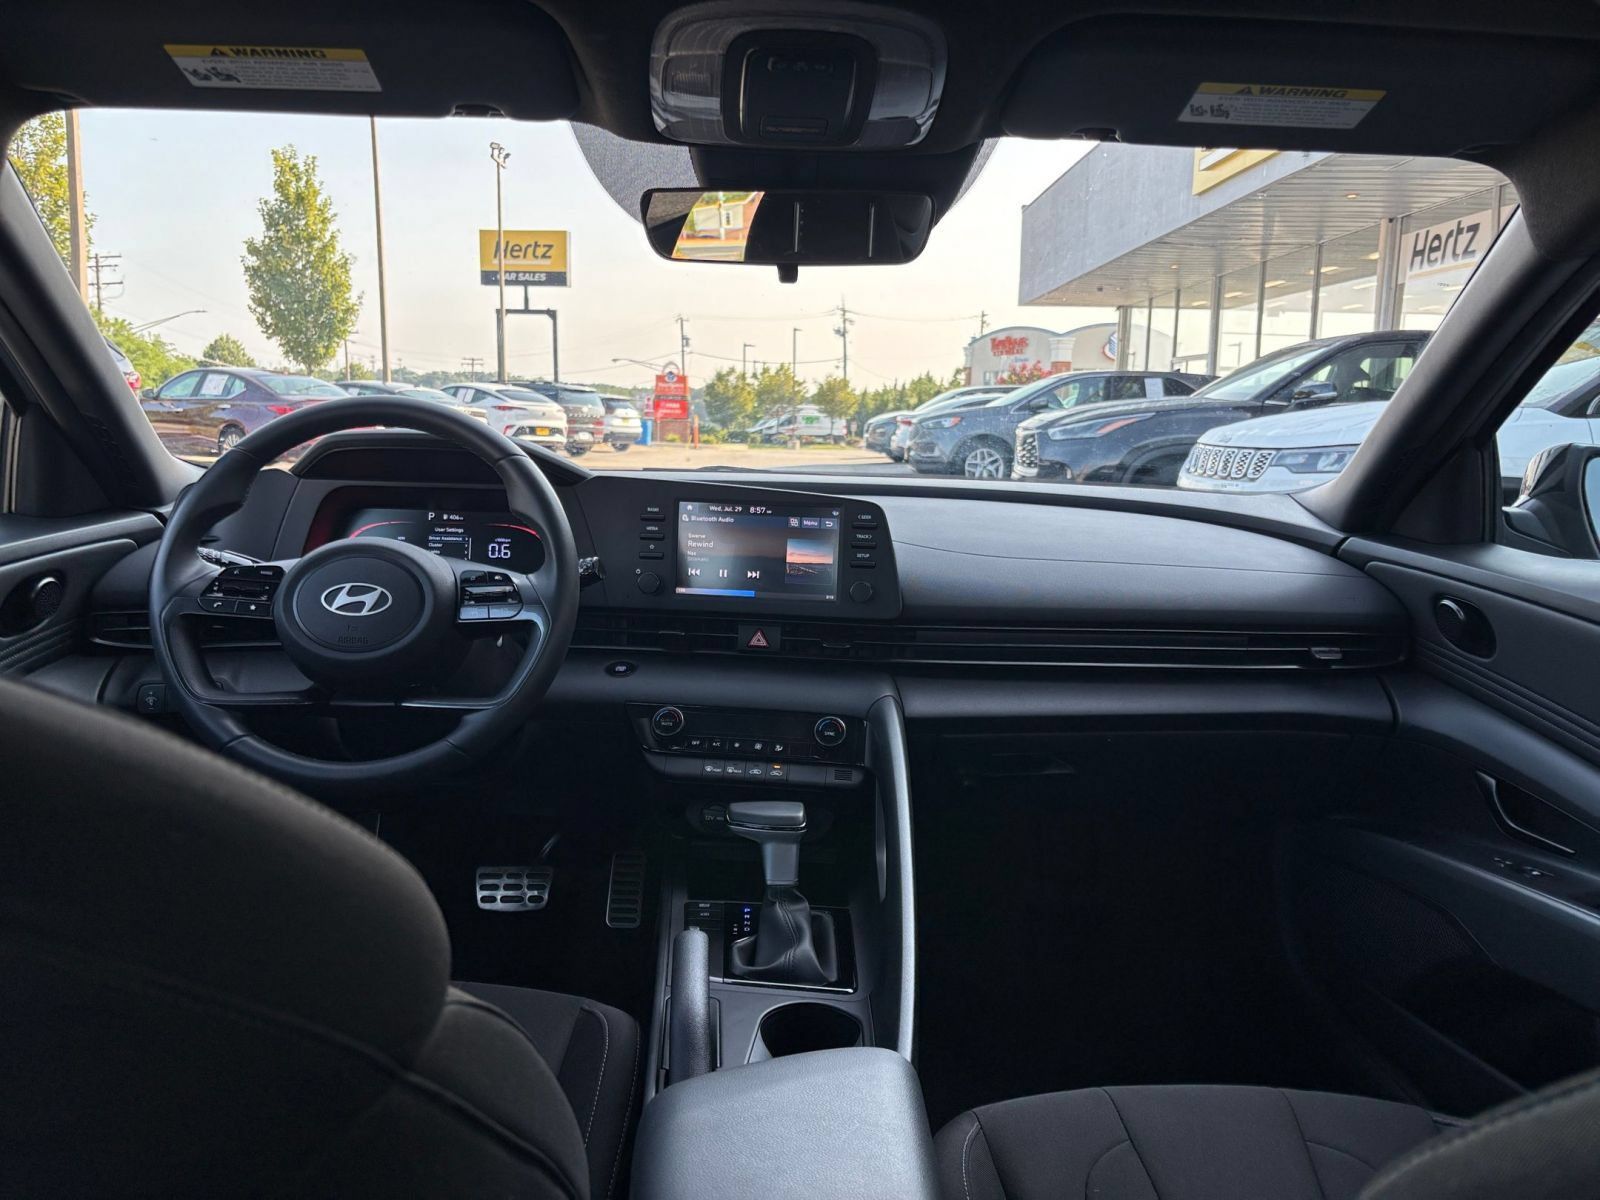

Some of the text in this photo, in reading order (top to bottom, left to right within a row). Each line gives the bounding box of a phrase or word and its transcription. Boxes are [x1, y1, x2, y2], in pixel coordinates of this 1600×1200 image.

[229, 48, 326, 59] WARNING
[1259, 86, 1348, 98] WARNING
[493, 240, 554, 260] Hertz
[1409, 219, 1481, 272] Hertz
[497, 273, 547, 281] AR SALES
[749, 506, 766, 514] 8:57
[428, 512, 436, 520] P
[687, 540, 714, 548] Rewind
[488, 543, 511, 558] 0.6
